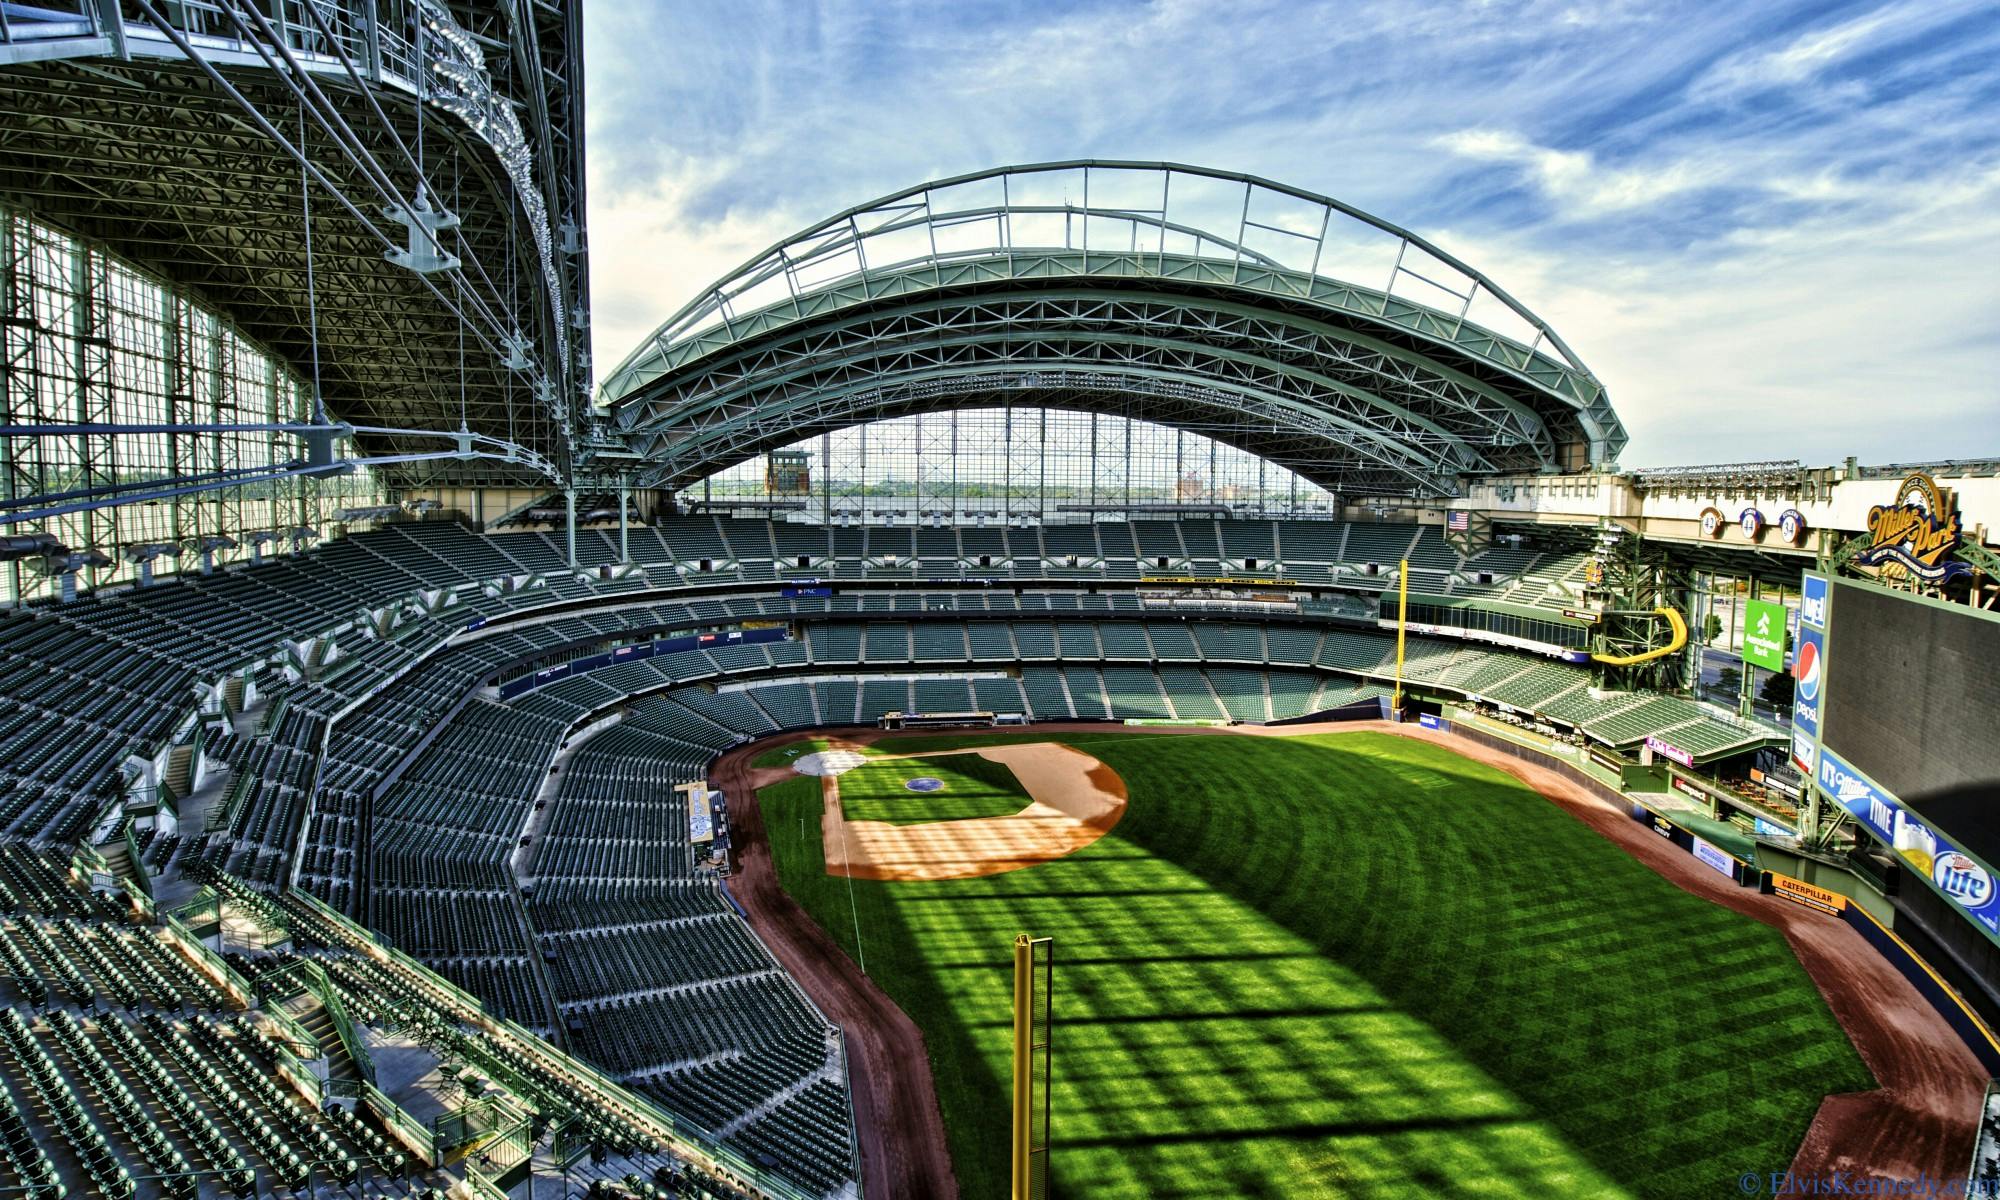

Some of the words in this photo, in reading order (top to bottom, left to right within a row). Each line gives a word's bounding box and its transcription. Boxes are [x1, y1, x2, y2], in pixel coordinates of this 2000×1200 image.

[1868, 505, 1919, 547] Miller
[1907, 515, 1957, 559] Park
[1836, 772, 1872, 802] Miller
[1952, 853, 1976, 871] Miller
[1782, 880, 1833, 903] CATERPILLAR
[1944, 865, 1985, 897] Lite
